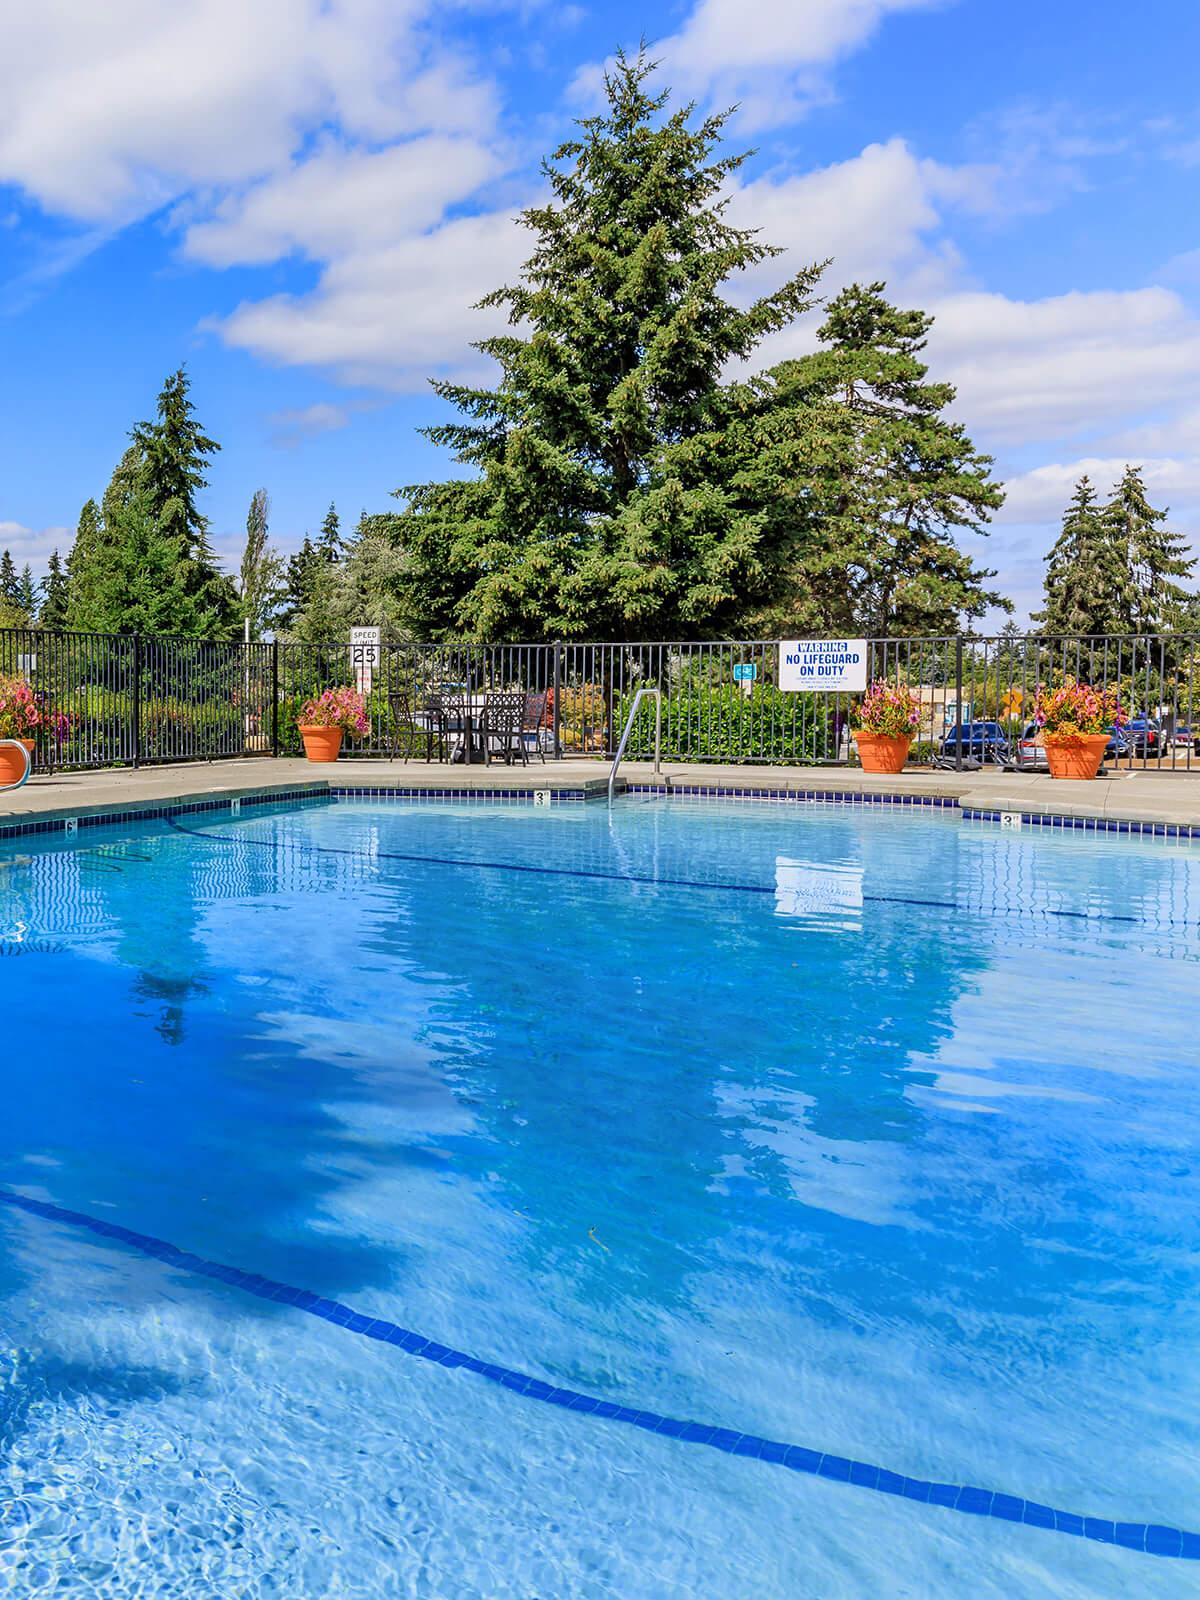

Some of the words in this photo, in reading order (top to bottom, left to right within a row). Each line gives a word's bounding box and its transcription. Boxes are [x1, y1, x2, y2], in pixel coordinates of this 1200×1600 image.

[799, 642, 847, 652] WARNING
[354, 648, 376, 662] 25
[786, 654, 800, 664] NO
[804, 654, 860, 664] LIFEGUARD
[800, 666, 814, 676] ON
[818, 666, 844, 676] DUTY
